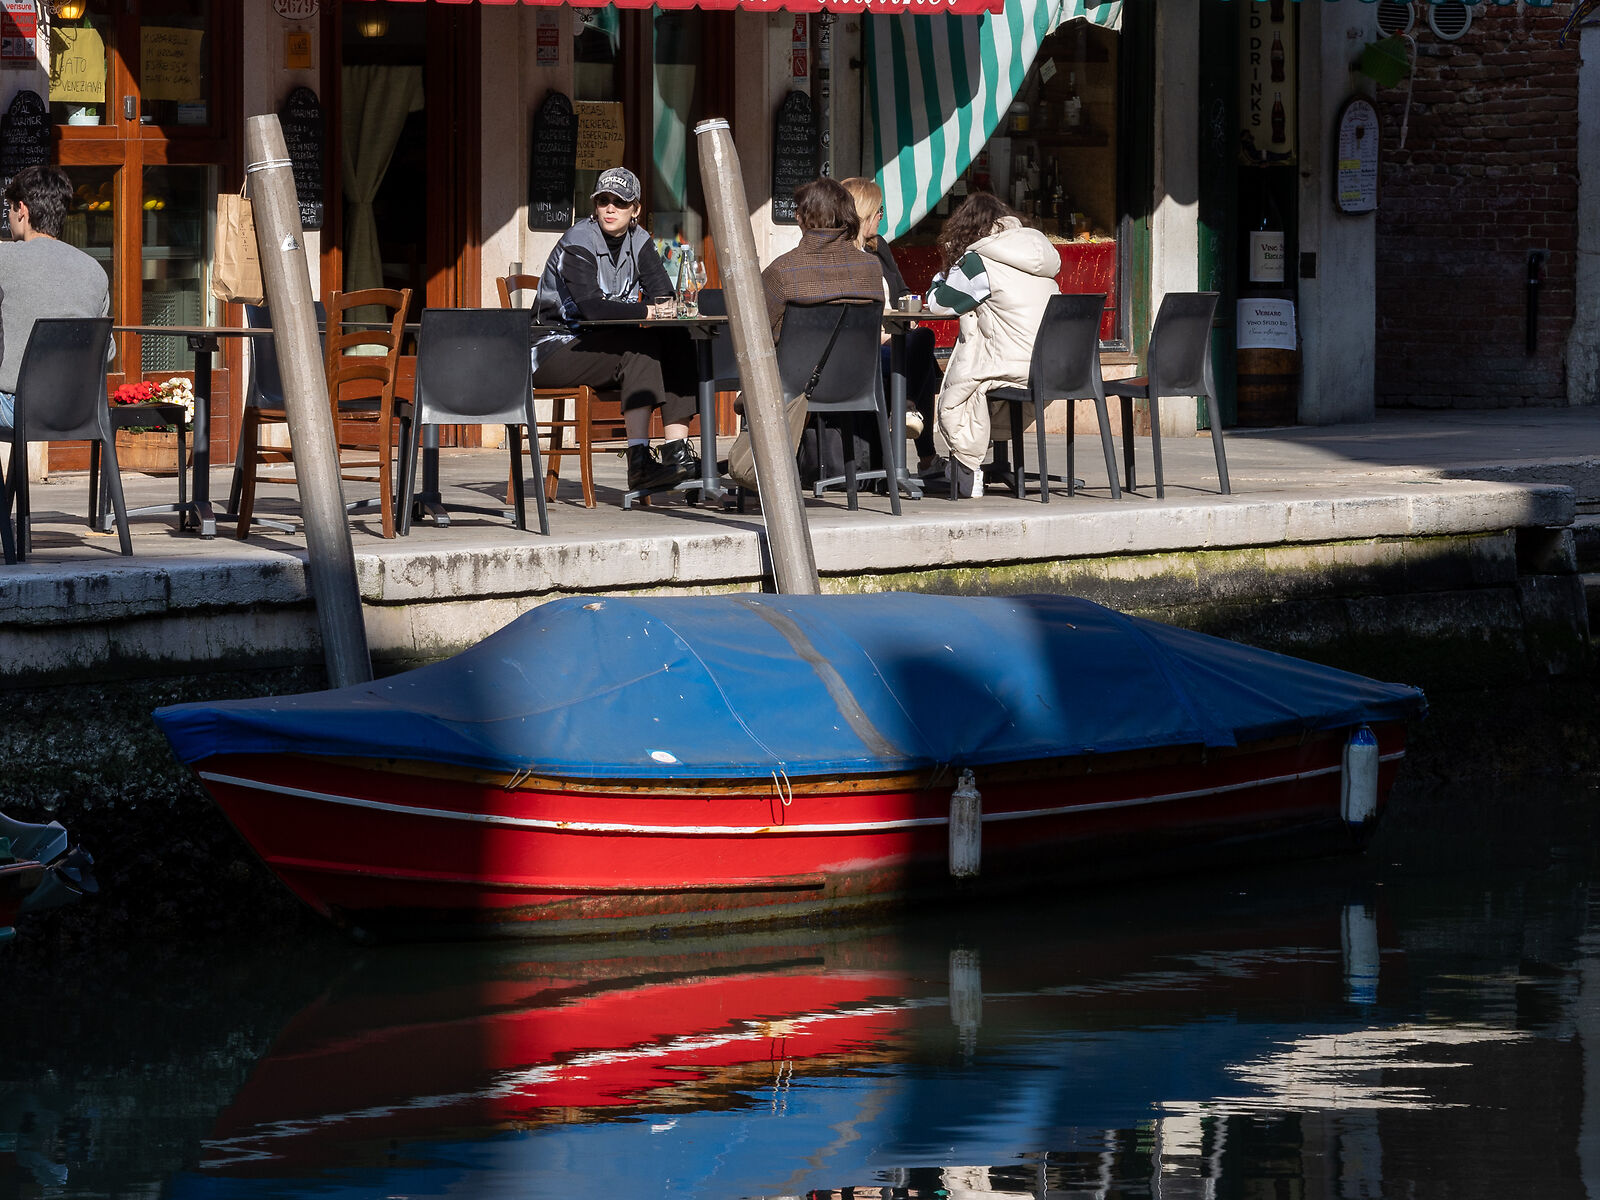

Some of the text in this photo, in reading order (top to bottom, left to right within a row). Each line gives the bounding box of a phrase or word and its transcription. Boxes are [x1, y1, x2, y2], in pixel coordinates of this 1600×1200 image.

[1250, 1, 1261, 126] LD DRINKS
[62, 80, 102, 94] VENEZIANA
[575, 104, 606, 116] ERCASI
[601, 176, 628, 188] VENEZIA
[536, 201, 552, 212] VINI
